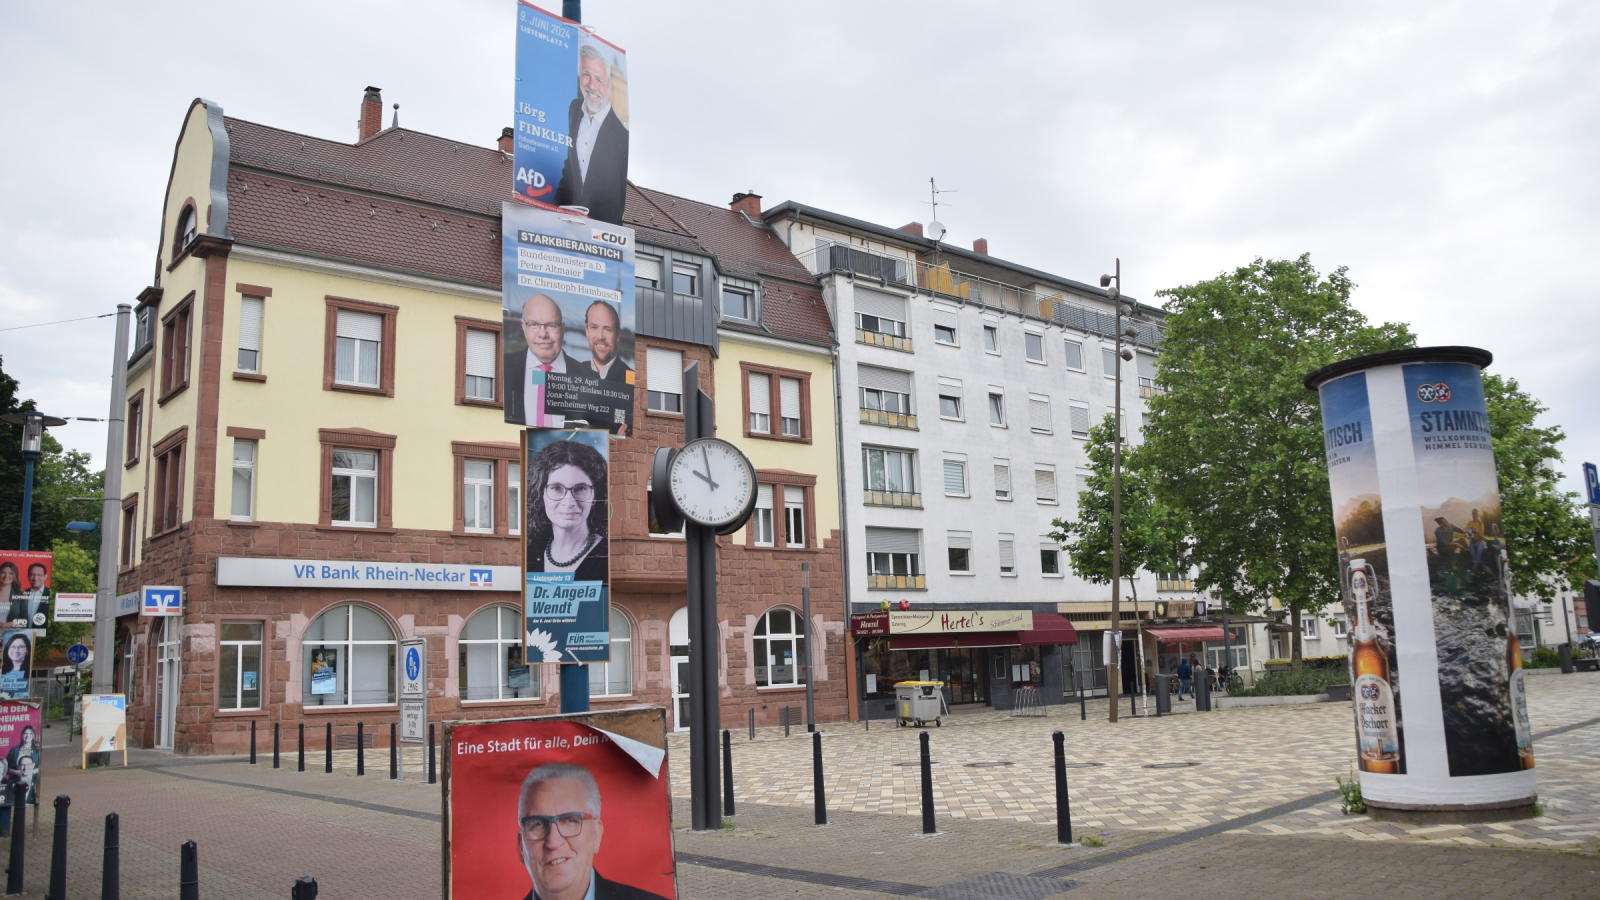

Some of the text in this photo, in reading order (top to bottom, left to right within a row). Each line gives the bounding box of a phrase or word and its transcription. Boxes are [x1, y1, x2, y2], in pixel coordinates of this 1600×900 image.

[520, 10, 570, 39] 9. JUNI 2024
[521, 25, 562, 46] LISTENPLATZ
[519, 102, 546, 122] Jörg
[519, 120, 573, 147] FINKLER
[516, 167, 545, 188] AfD
[521, 232, 620, 259] STARKBIERANSTICH
[602, 232, 626, 246] CDU
[520, 248, 602, 271] Bundesminister a.D.
[520, 260, 582, 277] Peter Altmaier
[520, 276, 619, 300] Dr. Christoph Hambusch
[546, 391, 578, 400] Jona-Saal
[580, 386, 601, 395] (Einlass
[603, 390, 617, 398] 18:30
[547, 400, 587, 409] Viernheimer
[588, 404, 599, 412] Weg
[1588, 468, 1597, 499] P
[294, 565, 465, 582] VR Bank Rhein-Neckar
[533, 586, 596, 601] Dr. Angela
[533, 602, 572, 614] Wendt
[569, 634, 584, 643] FÜR
[1360, 702, 1386, 715] Hacker
[458, 742, 484, 754] Eine
[488, 739, 521, 753] Stadt
[524, 738, 542, 750] für
[545, 736, 570, 750] alle,
[574, 733, 598, 746] Dein
